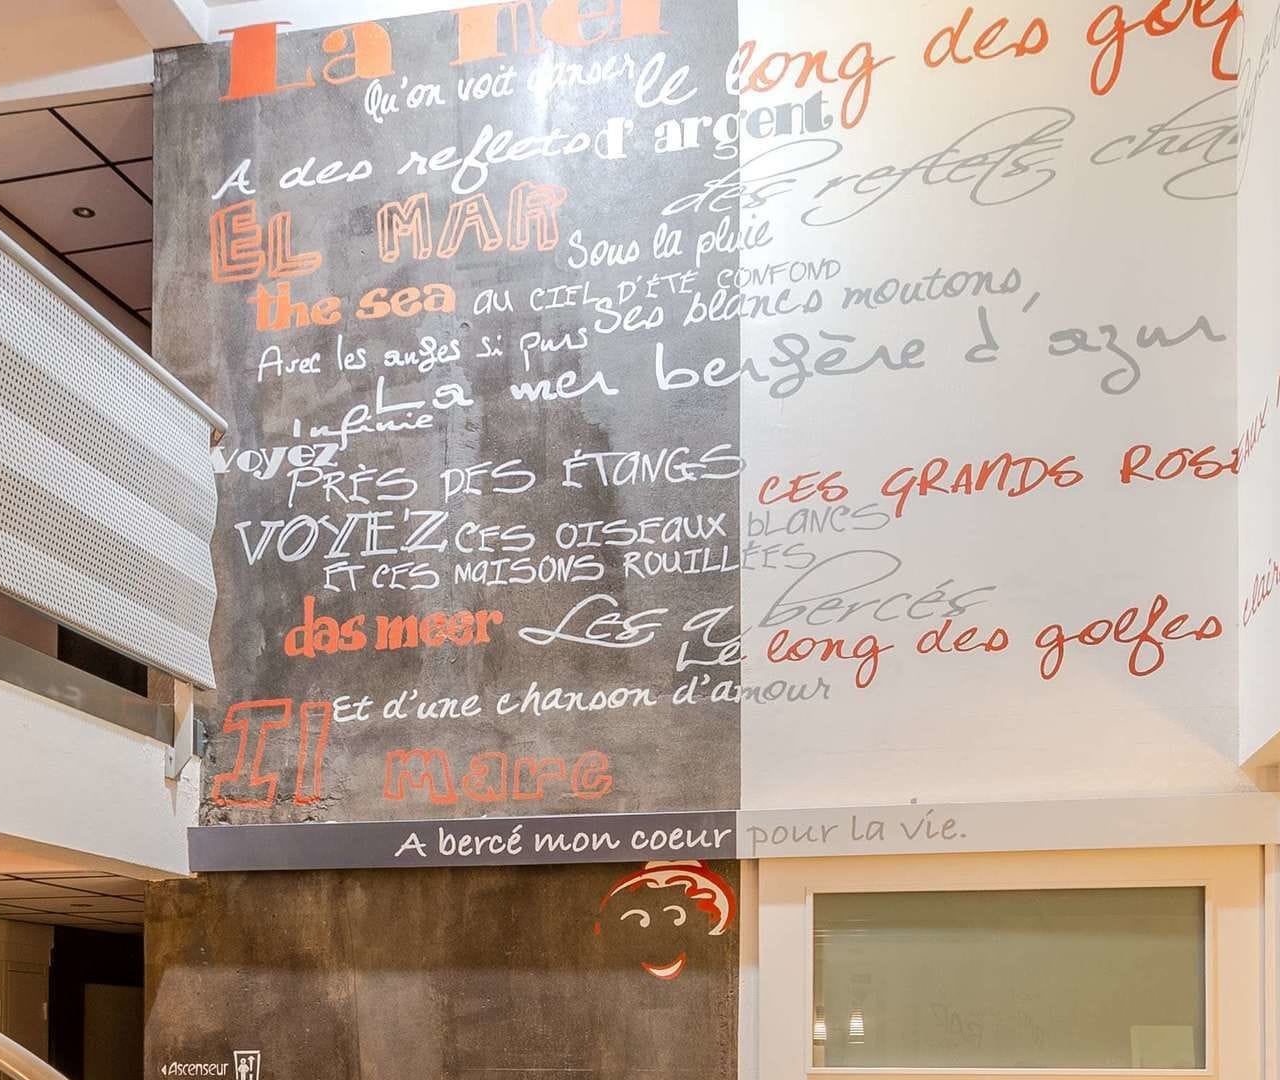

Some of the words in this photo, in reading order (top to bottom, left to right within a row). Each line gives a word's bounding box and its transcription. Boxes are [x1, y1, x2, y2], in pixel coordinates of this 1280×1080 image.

[219, 20, 396, 101] La
[364, 79, 446, 123] Qu'on
[457, 64, 517, 100] voit
[527, 53, 636, 96] danser
[634, 51, 698, 108] le
[724, 40, 895, 129] long
[924, 7, 1050, 69] des
[211, 164, 257, 200] A
[280, 150, 372, 187] des
[397, 124, 587, 194] reflets
[661, 139, 842, 216] des
[801, 107, 1075, 226] reflets
[209, 199, 322, 284] EL
[376, 181, 569, 264] MAR
[568, 229, 641, 269] Sous
[652, 221, 684, 259] la
[696, 214, 774, 267] pluie
[246, 282, 343, 332] the
[355, 281, 457, 322] sea
[529, 282, 602, 310] CIEL
[717, 257, 841, 290] CONFOND
[594, 296, 664, 334] Ses
[683, 285, 822, 328] blancs
[257, 345, 322, 383] Avec
[337, 334, 367, 371] les
[383, 336, 461, 373] anges
[375, 375, 474, 414] La
[510, 370, 619, 402] mer
[1048, 316, 1226, 395] azur
[210, 442, 340, 480] voyez
[286, 464, 418, 508] PRÈS
[440, 459, 536, 502] DES
[758, 470, 849, 505] CES
[880, 452, 1085, 519] GRANDS
[455, 522, 536, 554] CES
[555, 513, 728, 551] OISEAUX
[323, 561, 365, 593] ET
[372, 562, 440, 591] CES
[454, 555, 605, 586] MAISONS
[519, 593, 670, 649] Les
[757, 550, 997, 629] bercés
[283, 594, 367, 659] das
[374, 608, 503, 651] meer
[675, 640, 748, 673] Le
[767, 628, 895, 689] long
[916, 618, 1011, 656] des
[1034, 594, 1223, 680] golfes
[332, 693, 372, 722] Et
[383, 687, 483, 721] d'une
[496, 680, 658, 718] chanson
[672, 672, 831, 705] d'amour
[383, 747, 614, 806] mare
[394, 835, 427, 859] A
[437, 824, 523, 858] bercé
[534, 829, 621, 853] mon
[630, 825, 733, 852] coeur
[747, 822, 839, 849] pour
[850, 813, 893, 842] la
[899, 808, 967, 843] vie.
[168, 1060, 229, 1078] Ascenseur
